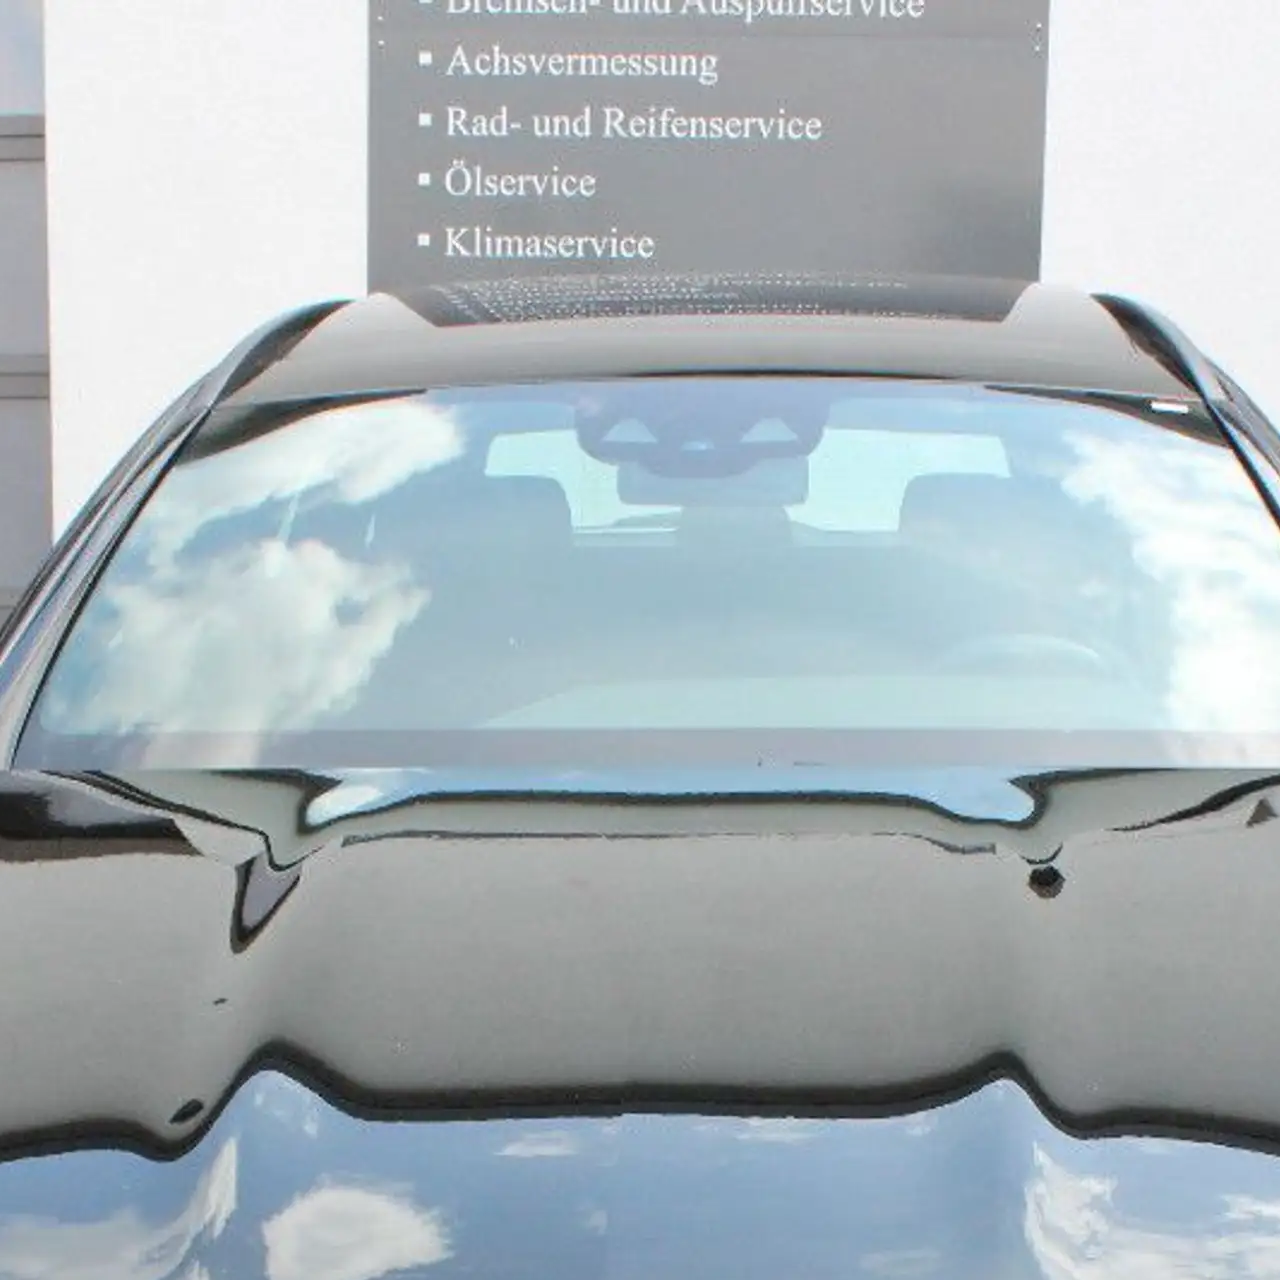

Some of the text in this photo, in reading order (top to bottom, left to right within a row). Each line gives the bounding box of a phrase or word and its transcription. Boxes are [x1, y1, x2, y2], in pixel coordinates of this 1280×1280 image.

[446, 45, 718, 85] Achsvermessung
[446, 106, 823, 140] Rad- und Reifenservice
[445, 159, 597, 197] Ölservice
[445, 227, 656, 259] Klimaservice
